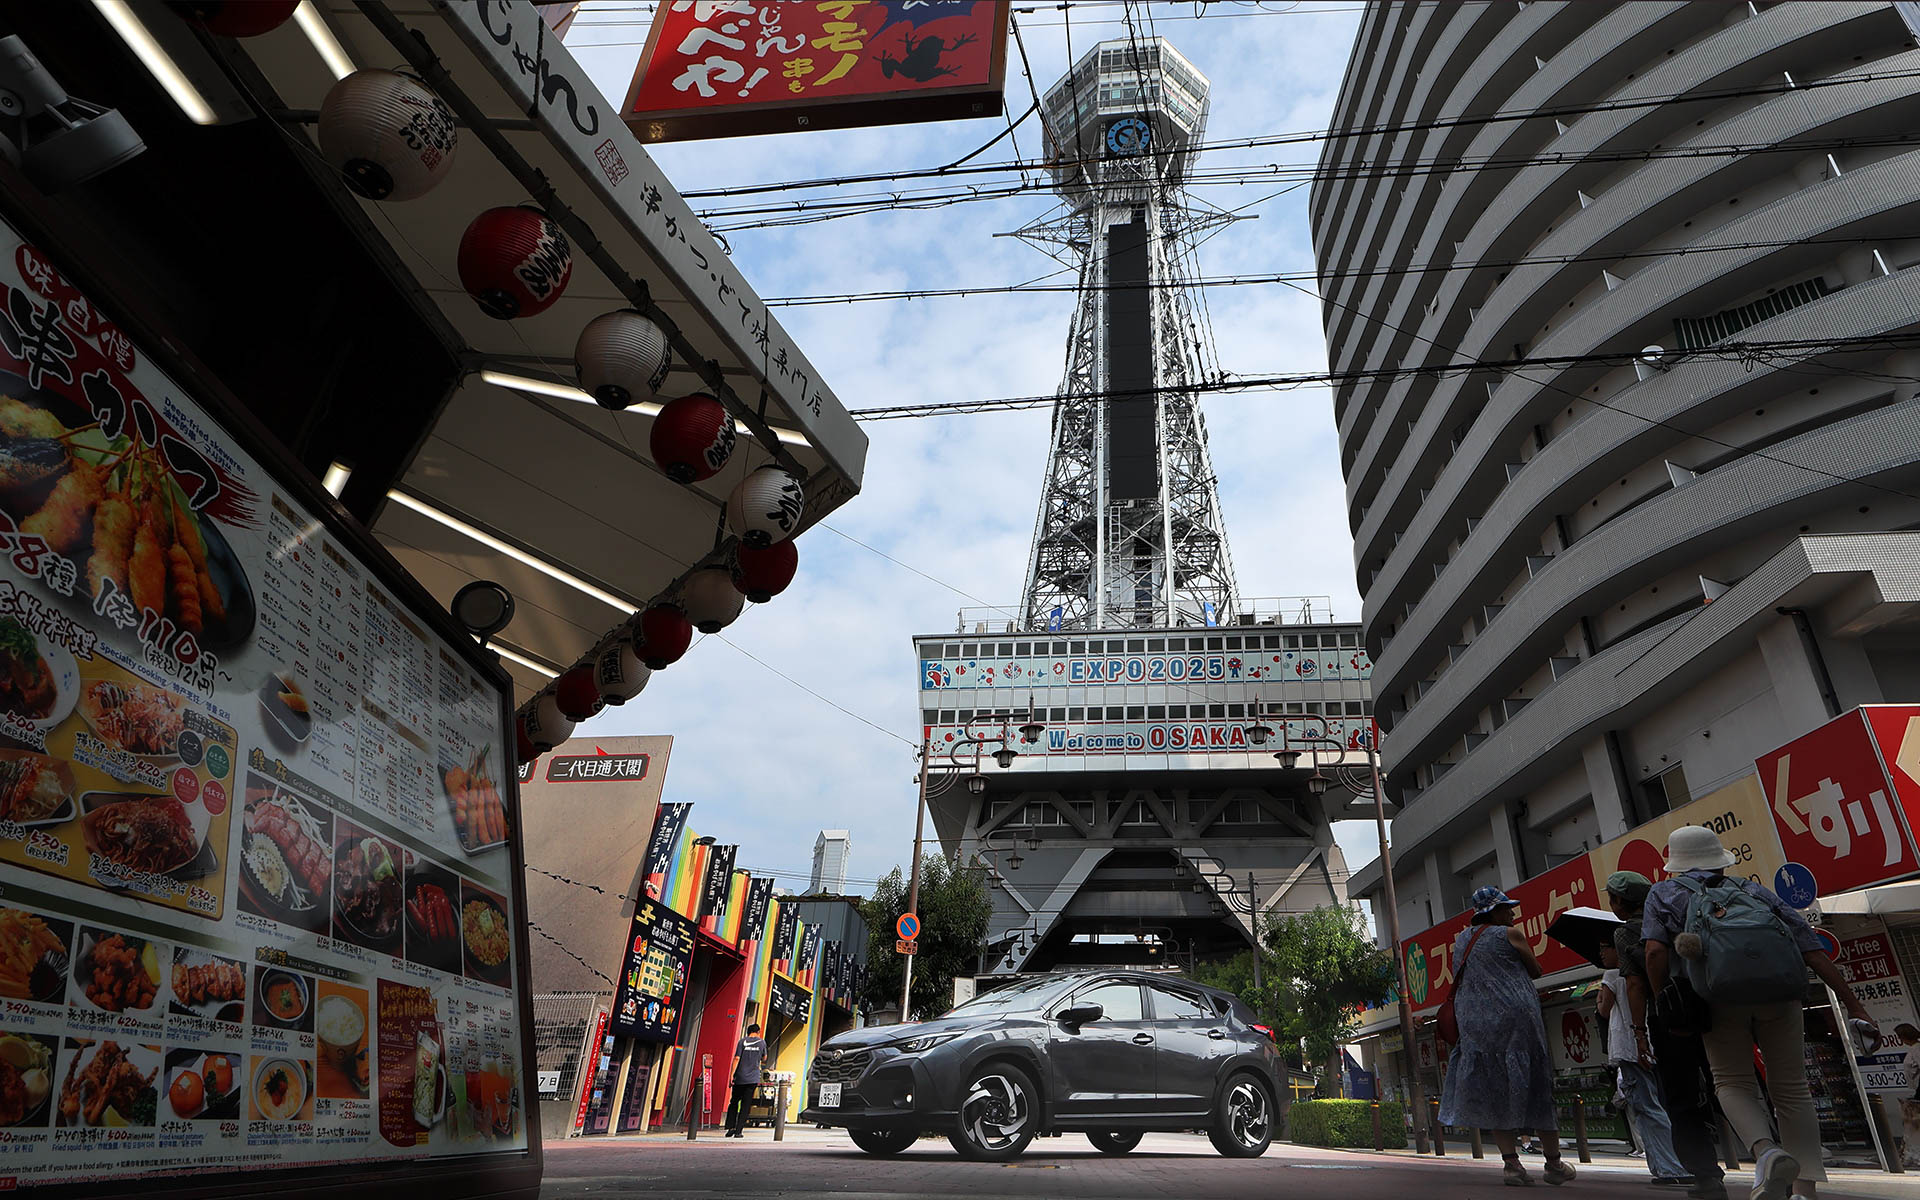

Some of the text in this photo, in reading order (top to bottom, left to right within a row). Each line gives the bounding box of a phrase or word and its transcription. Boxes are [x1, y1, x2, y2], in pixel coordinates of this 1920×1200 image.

[99, 641, 137, 670] Specialty
[1047, 724, 1247, 752] Welcome to OSAKA
[553, 758, 644, 779] 二代目通天閣
[1774, 753, 1903, 868] くすり
